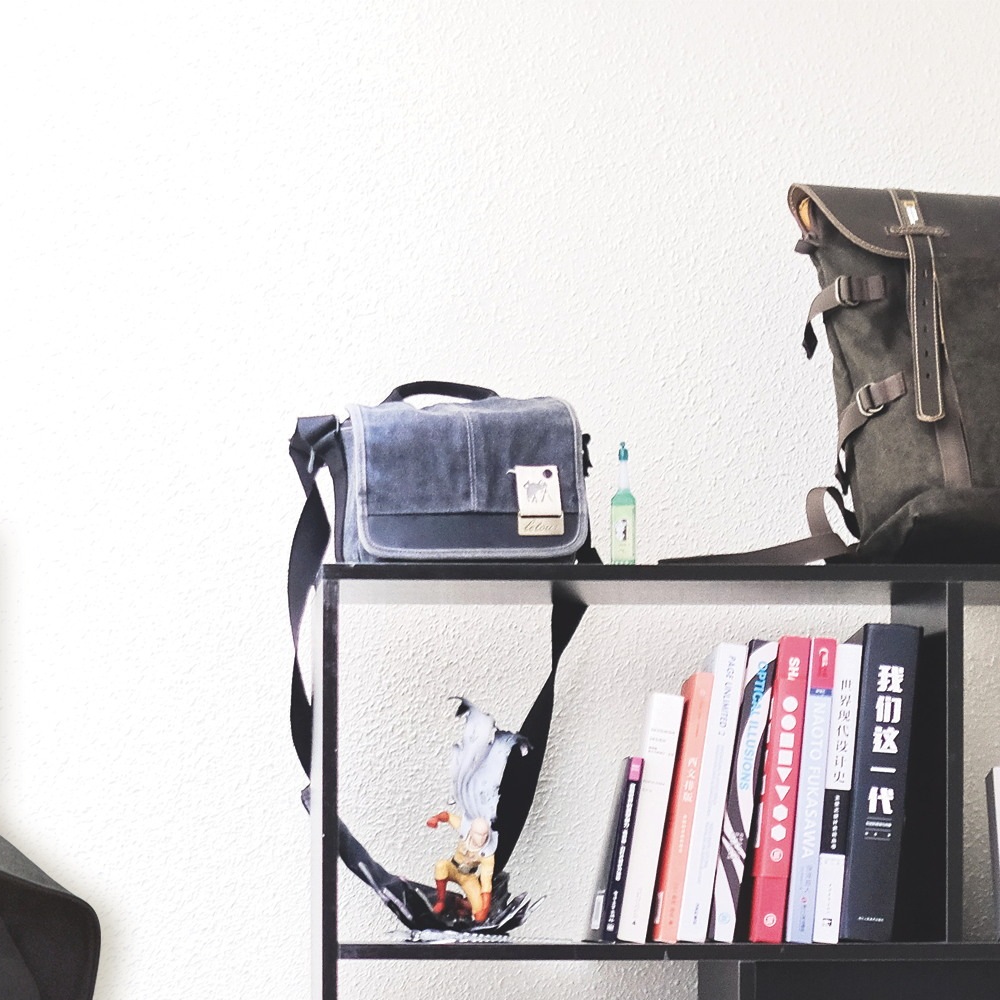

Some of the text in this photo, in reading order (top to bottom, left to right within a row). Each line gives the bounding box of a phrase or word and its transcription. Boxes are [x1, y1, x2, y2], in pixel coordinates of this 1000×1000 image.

[738, 660, 769, 791] OPTICAL ILLUSIONS
[801, 702, 827, 859] NAOTO FUKASAWA
[834, 679, 853, 783] 世界现代设计史
[868, 664, 905, 815] 我们这一代
